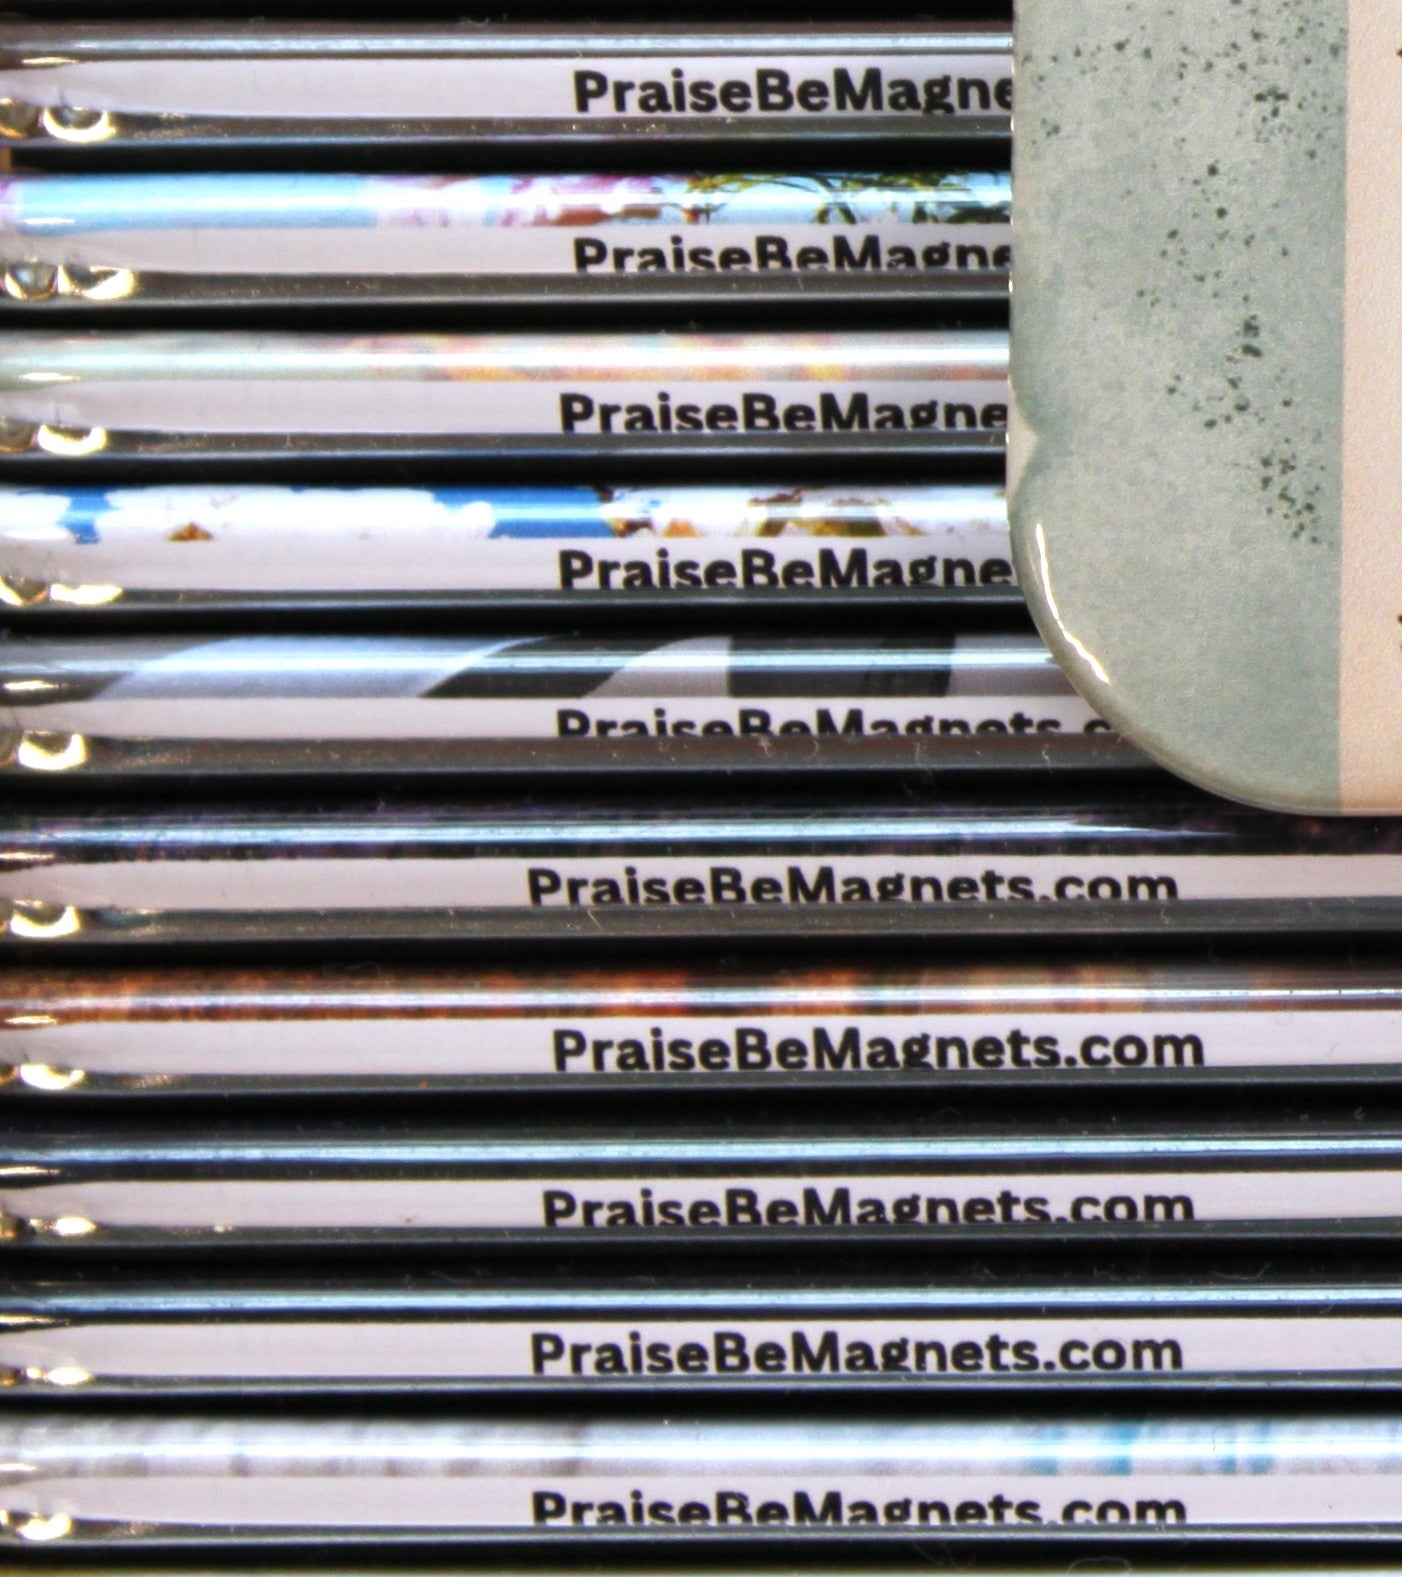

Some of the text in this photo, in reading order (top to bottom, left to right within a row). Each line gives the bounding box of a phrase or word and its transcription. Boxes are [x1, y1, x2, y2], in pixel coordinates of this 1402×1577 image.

[527, 866, 1178, 905] PraiseBeMagnets.com
[553, 1027, 1204, 1072] PraiseBeMagnets.com
[543, 1187, 1195, 1226] PraiseBeMagnets.com
[530, 1331, 1183, 1374] PraiseBeMagnets.com
